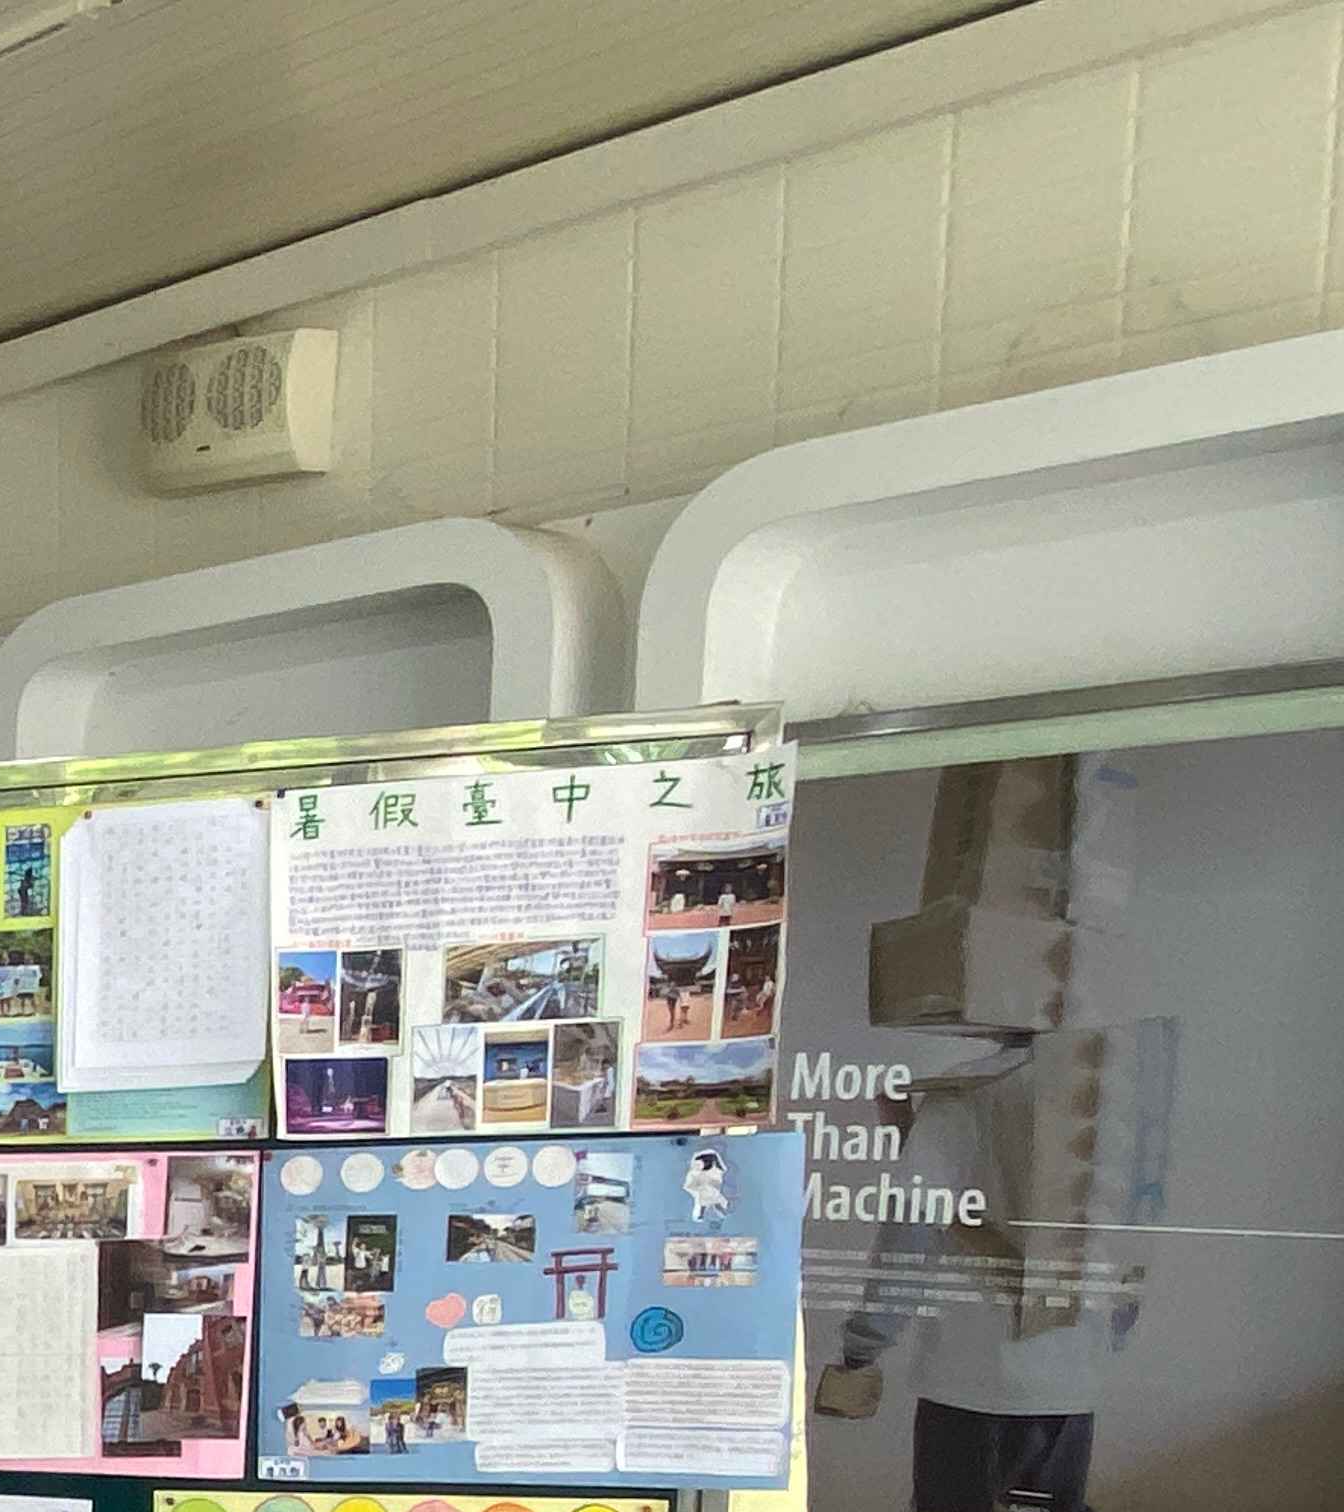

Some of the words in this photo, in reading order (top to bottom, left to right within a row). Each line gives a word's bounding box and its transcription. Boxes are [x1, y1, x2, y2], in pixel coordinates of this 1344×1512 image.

[289, 762, 786, 842] 暑假臺中之旅
[790, 1052, 912, 1101] More
